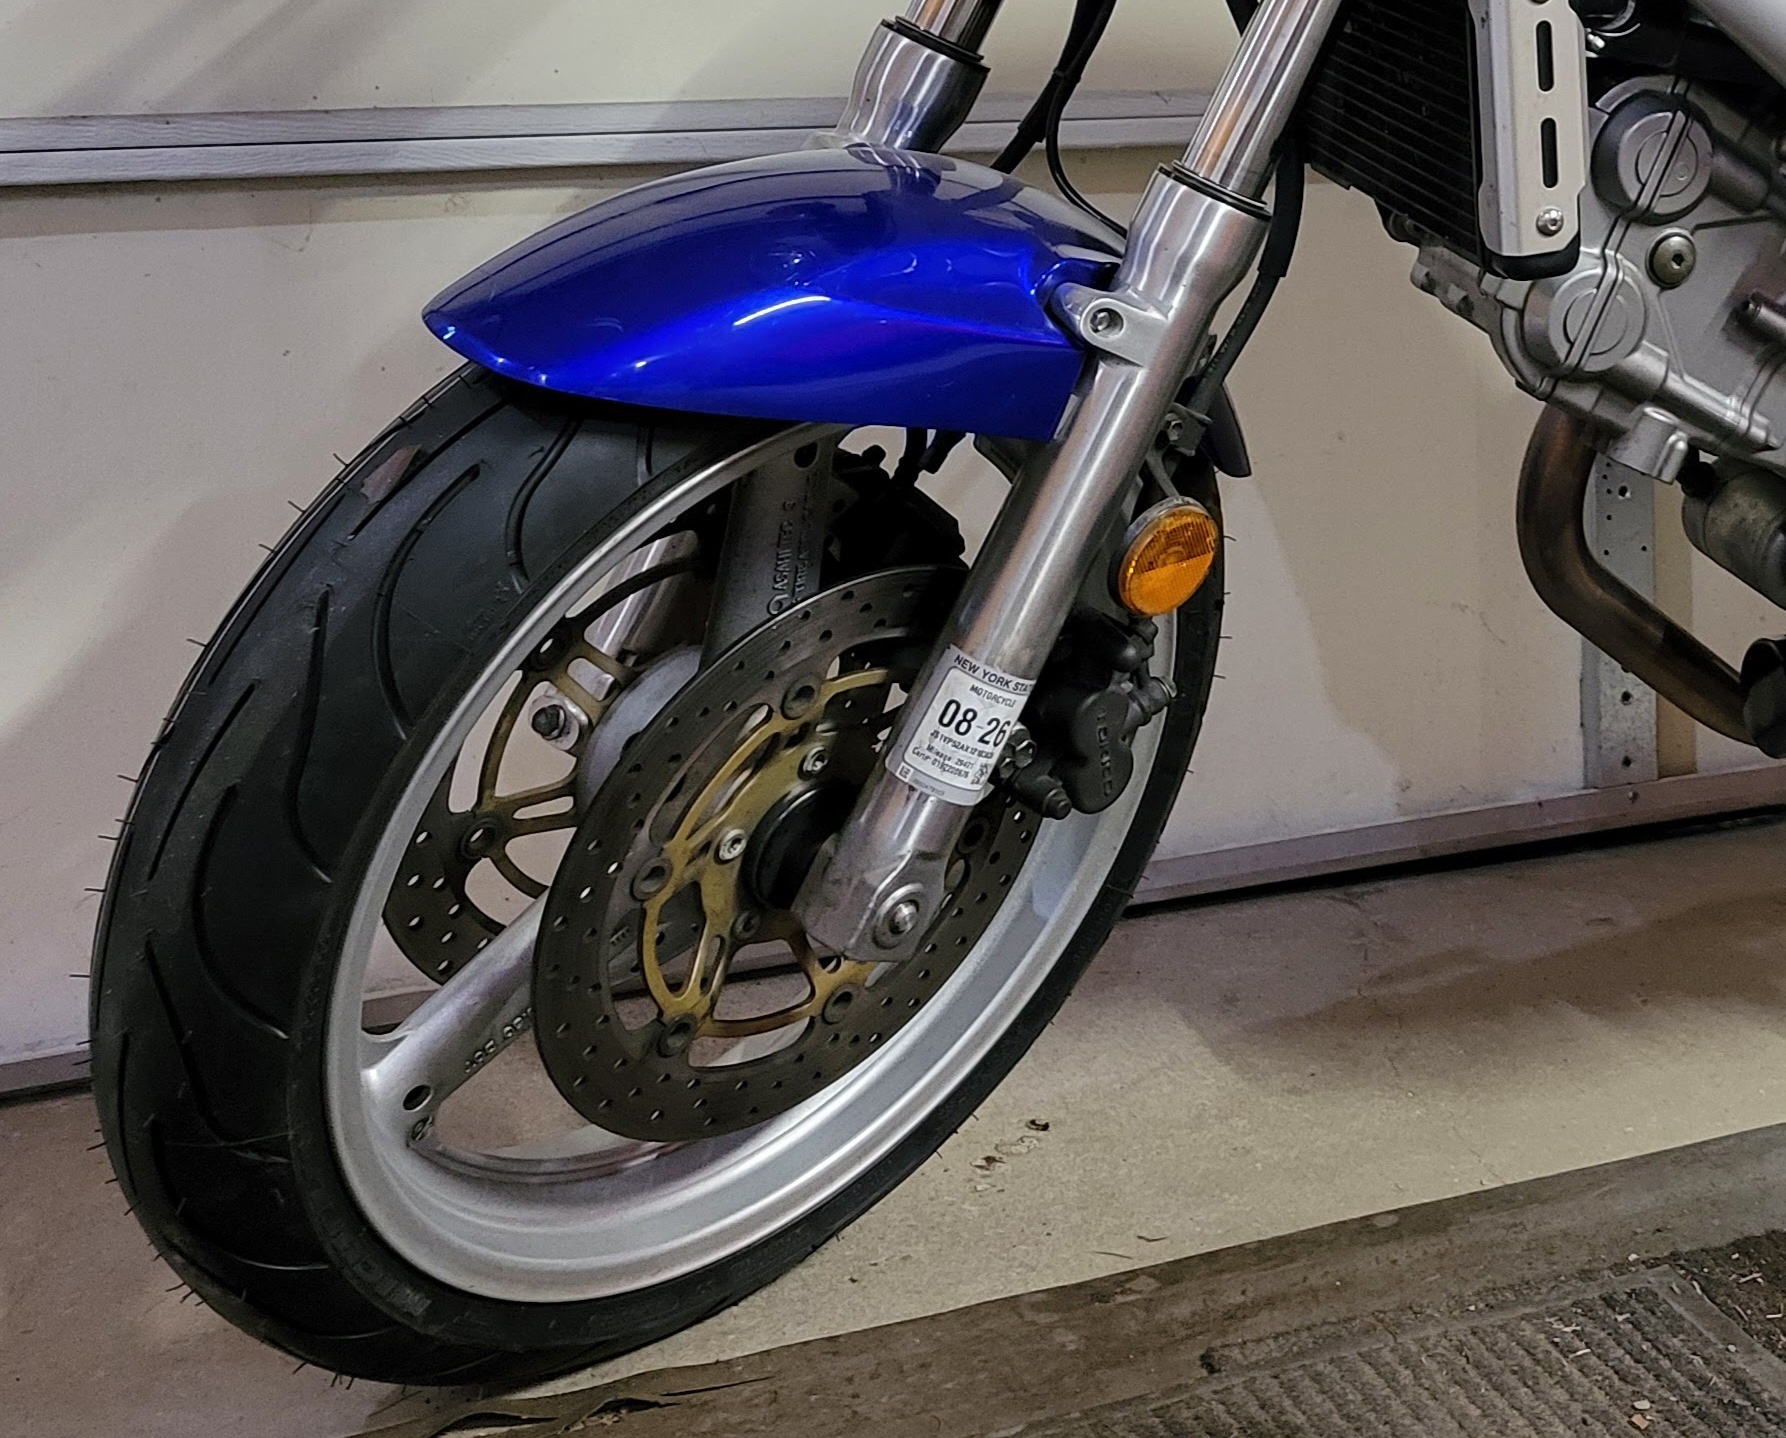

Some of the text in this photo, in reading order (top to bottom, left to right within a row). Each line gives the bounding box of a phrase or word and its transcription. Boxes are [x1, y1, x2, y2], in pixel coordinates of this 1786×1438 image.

[953, 654, 980, 674] NEW
[981, 669, 1010, 689] YORK
[969, 683, 1018, 708] MOTORCYCLE
[937, 698, 1012, 748] 08-26
